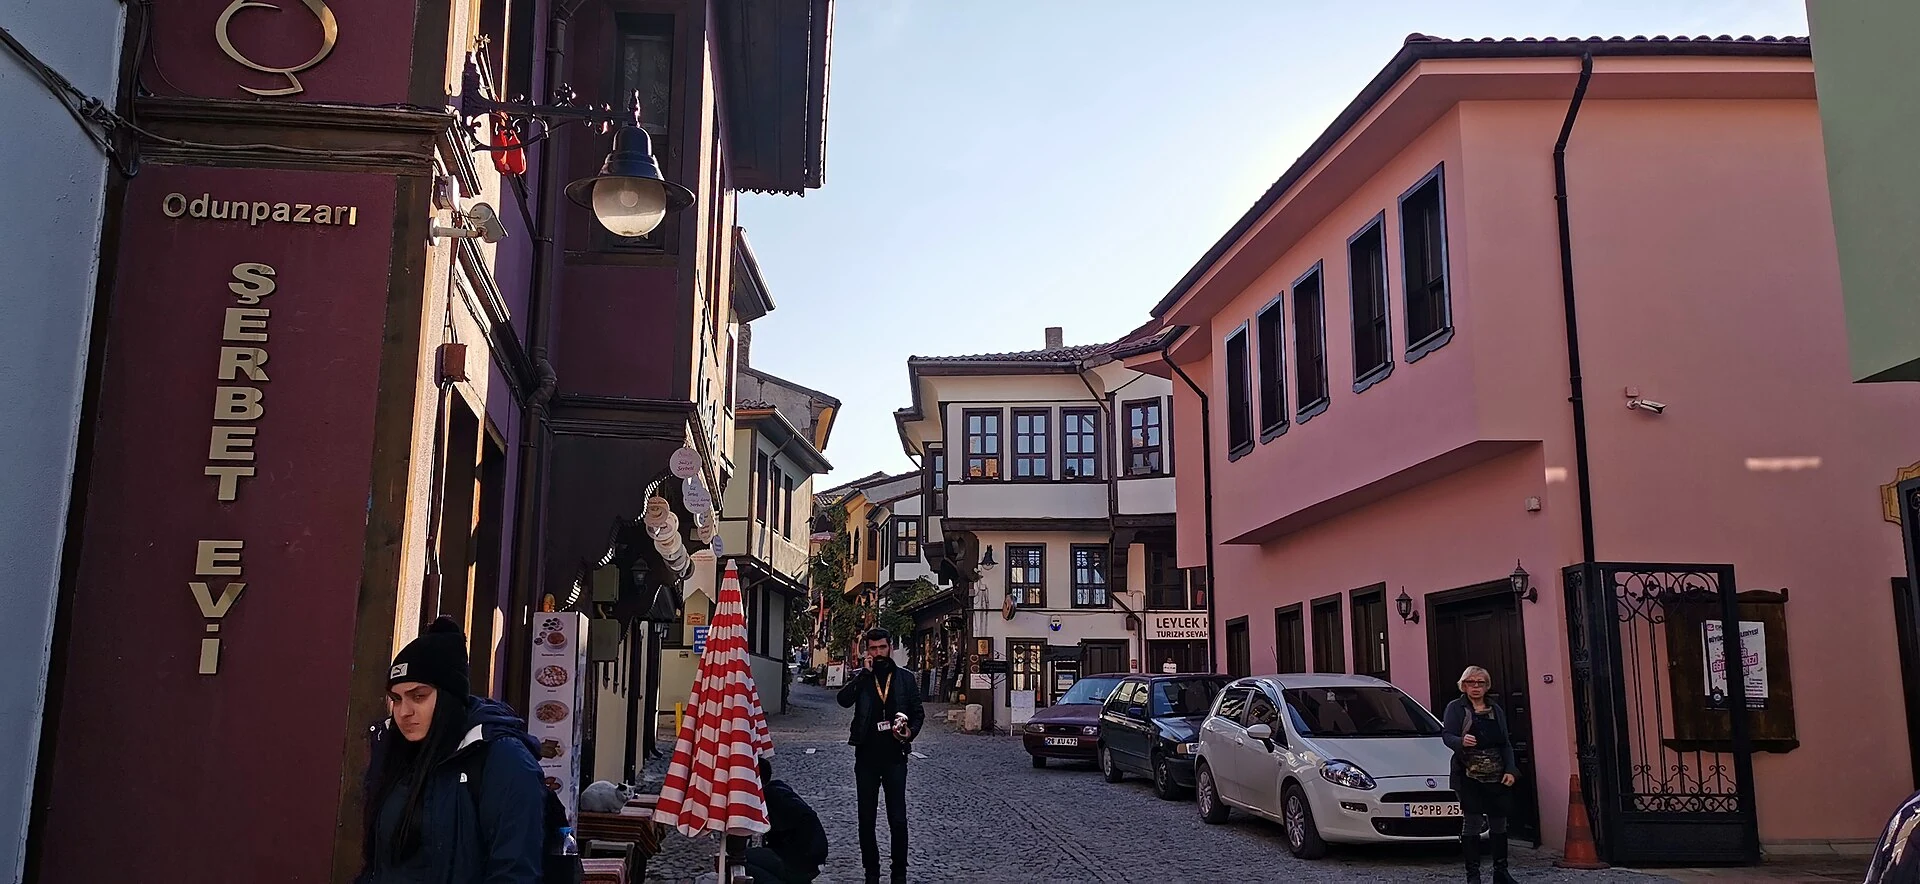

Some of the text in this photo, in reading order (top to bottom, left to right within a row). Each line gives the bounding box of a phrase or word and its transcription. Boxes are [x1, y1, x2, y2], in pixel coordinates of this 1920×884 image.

[162, 192, 358, 226] Odunpazarı
[203, 262, 277, 501] ŞERBET
[1156, 617, 1200, 628] LEYLEK
[1411, 804, 1424, 816] 43
[1429, 804, 1442, 816] PB
